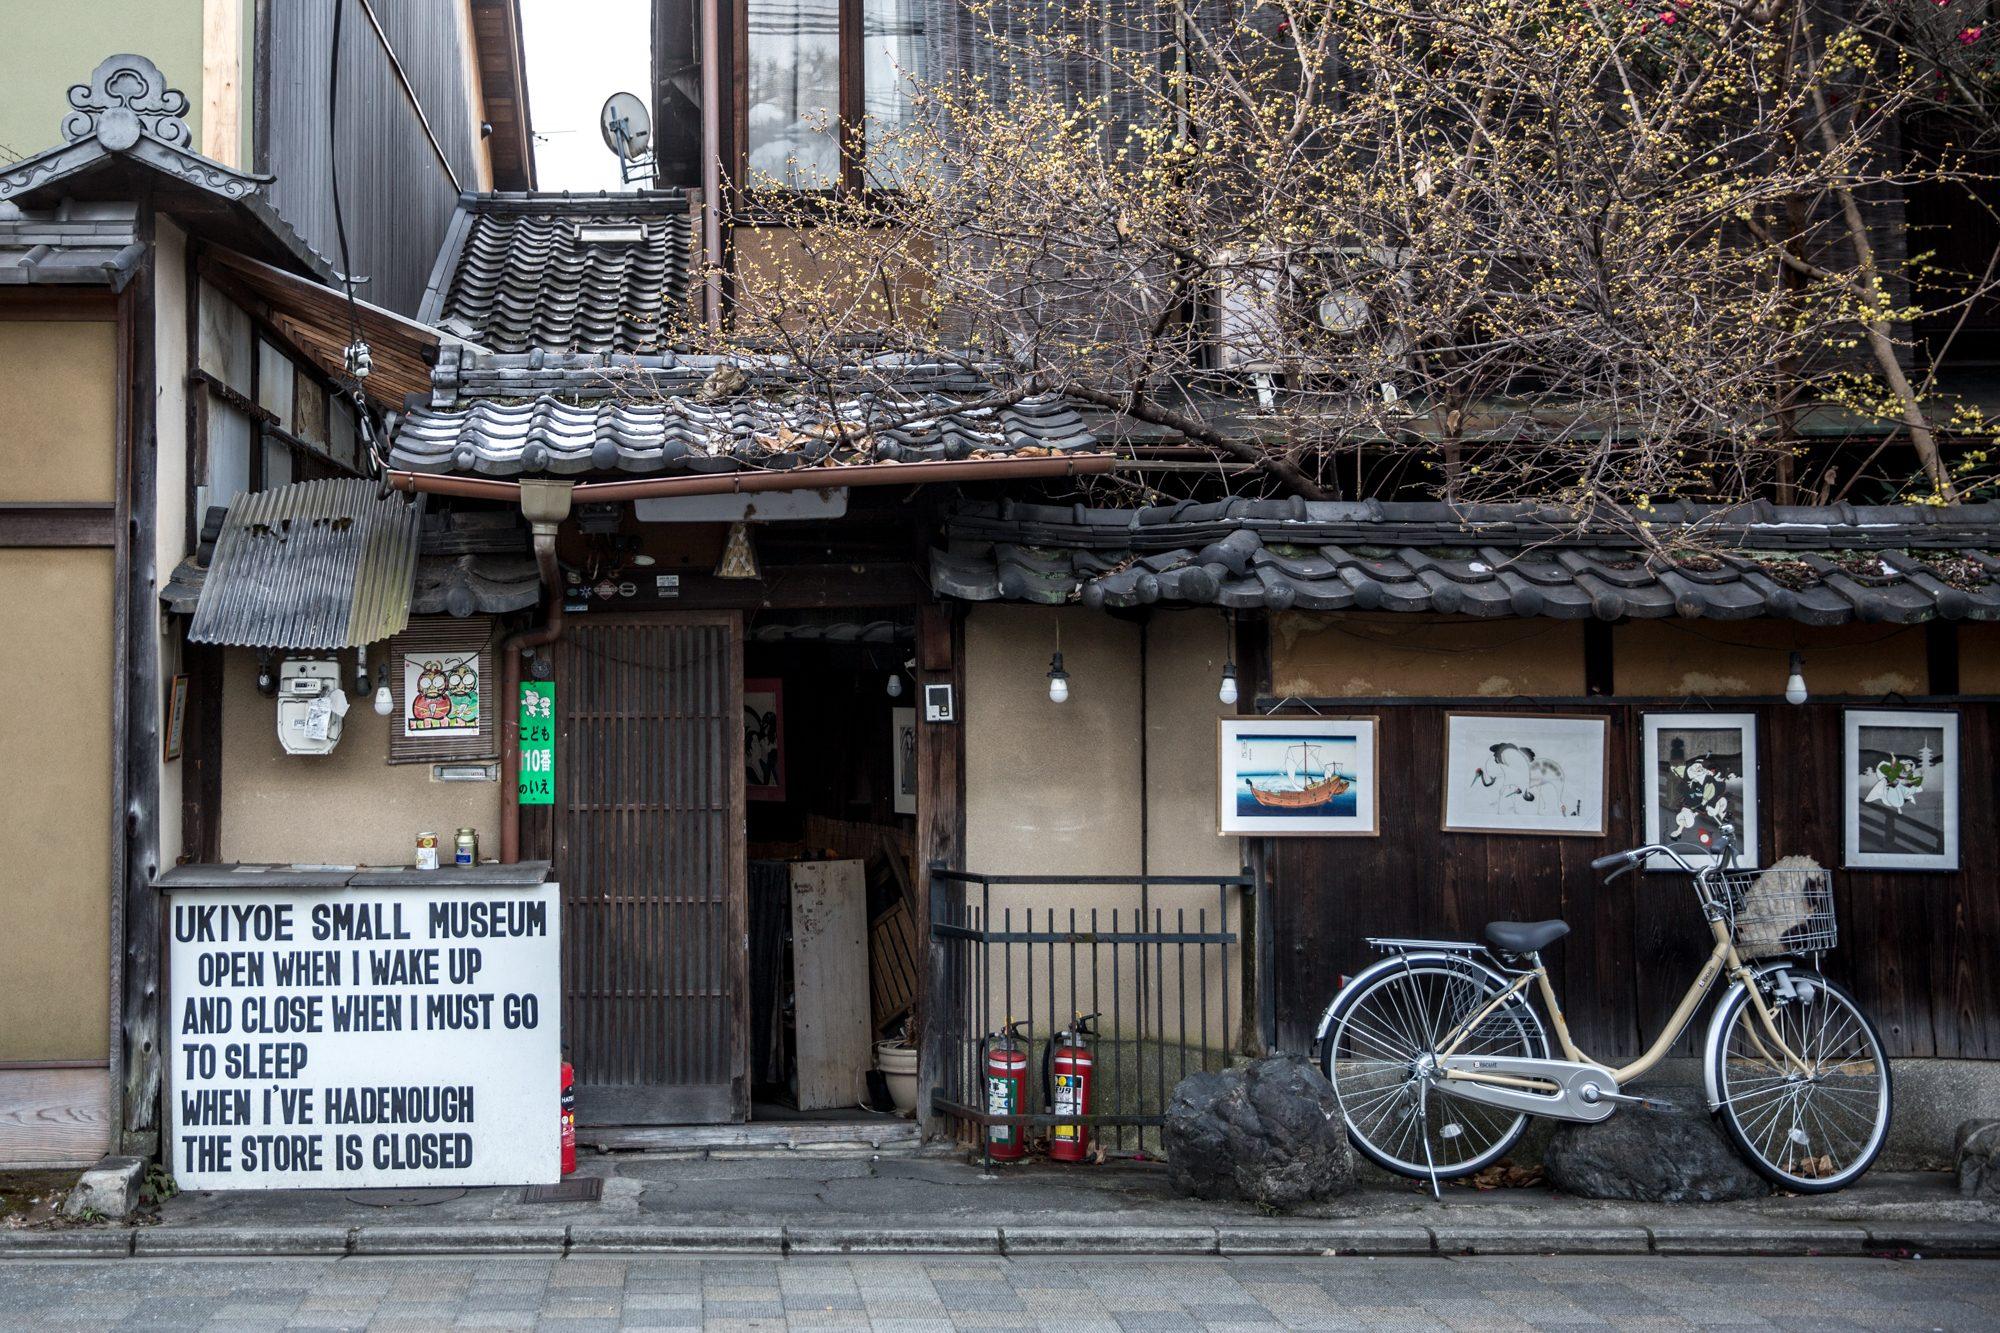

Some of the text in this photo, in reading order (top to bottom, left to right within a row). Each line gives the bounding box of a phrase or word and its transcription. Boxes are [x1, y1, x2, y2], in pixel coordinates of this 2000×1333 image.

[519, 725, 550, 742] こども
[518, 778, 550, 795] のいえ
[175, 900, 547, 943] UKIYOE SMALL MUSEUM
[198, 947, 482, 988] OPEN WHEN I WAKE UP
[181, 992, 539, 1035] AND CLOSE WHEN I MUST GO
[182, 1042, 308, 1081] TO SLEEP
[181, 1089, 251, 1127] WHEN
[263, 1084, 314, 1125] I'VE
[181, 1132, 473, 1173] THE STORE IS CLOSED
